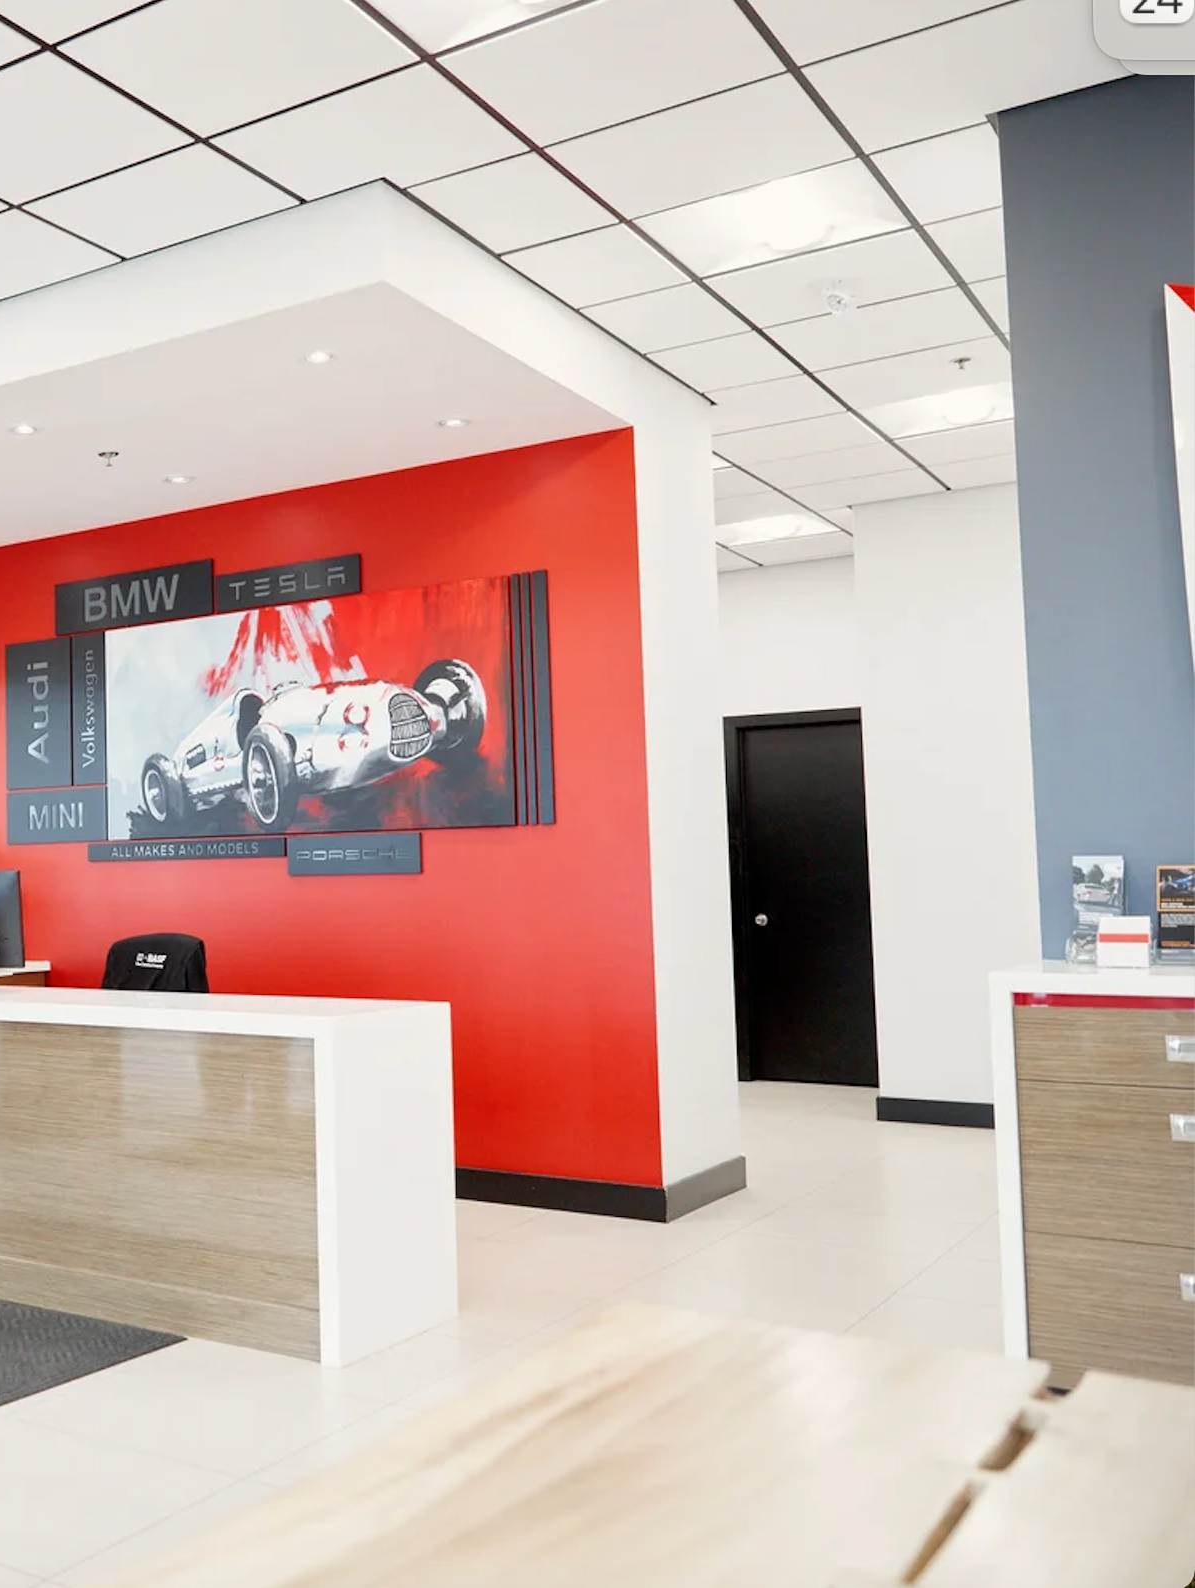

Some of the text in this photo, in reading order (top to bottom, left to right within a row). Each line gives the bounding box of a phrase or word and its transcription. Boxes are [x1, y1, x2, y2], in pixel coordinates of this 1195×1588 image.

[83, 573, 180, 623] BMW
[228, 566, 346, 601] TESLA
[26, 660, 50, 765] Audi
[80, 649, 99, 769] Volkswagen
[28, 802, 84, 831] MINI
[111, 841, 260, 858] ALL MAKES AND MODELS
